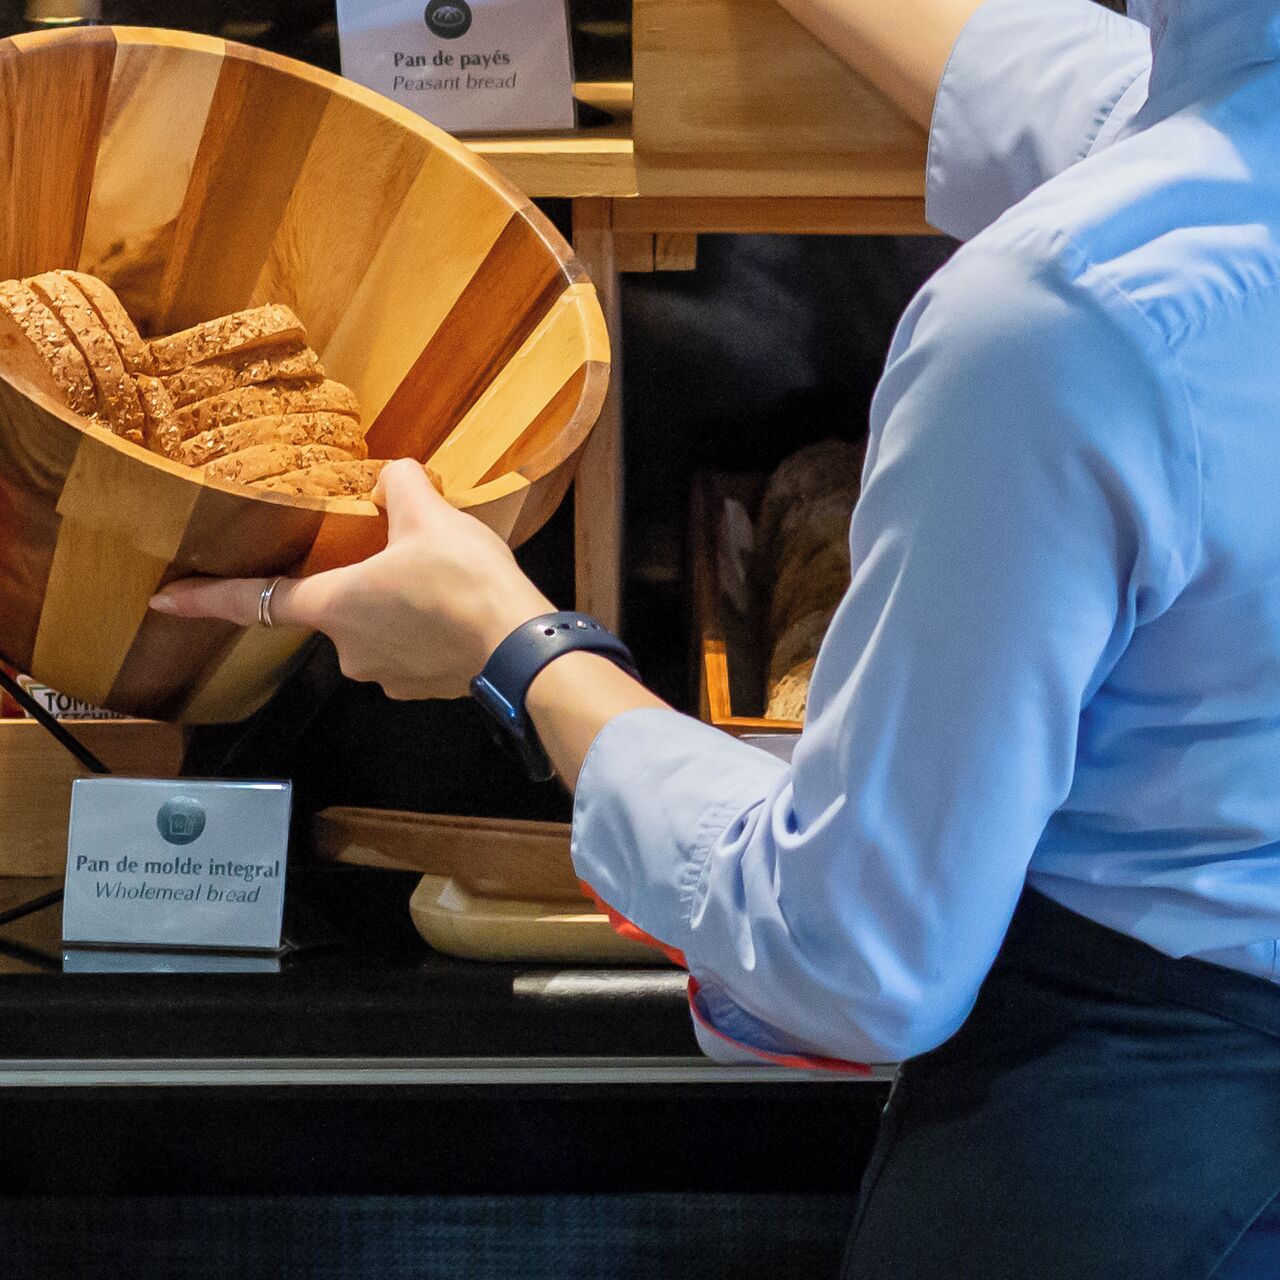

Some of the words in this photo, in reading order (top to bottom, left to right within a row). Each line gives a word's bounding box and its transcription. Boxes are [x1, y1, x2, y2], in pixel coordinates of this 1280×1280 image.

[394, 52, 426, 67] Pan
[432, 50, 454, 67] de
[460, 49, 510, 70] payés
[392, 73, 460, 91] Peasant
[466, 72, 517, 90] bread
[76, 855, 110, 872] Pan
[116, 855, 138, 873] de
[145, 857, 202, 876] molde
[209, 858, 280, 882] integral
[95, 880, 202, 901] Wholemeal
[206, 884, 261, 903] bread
